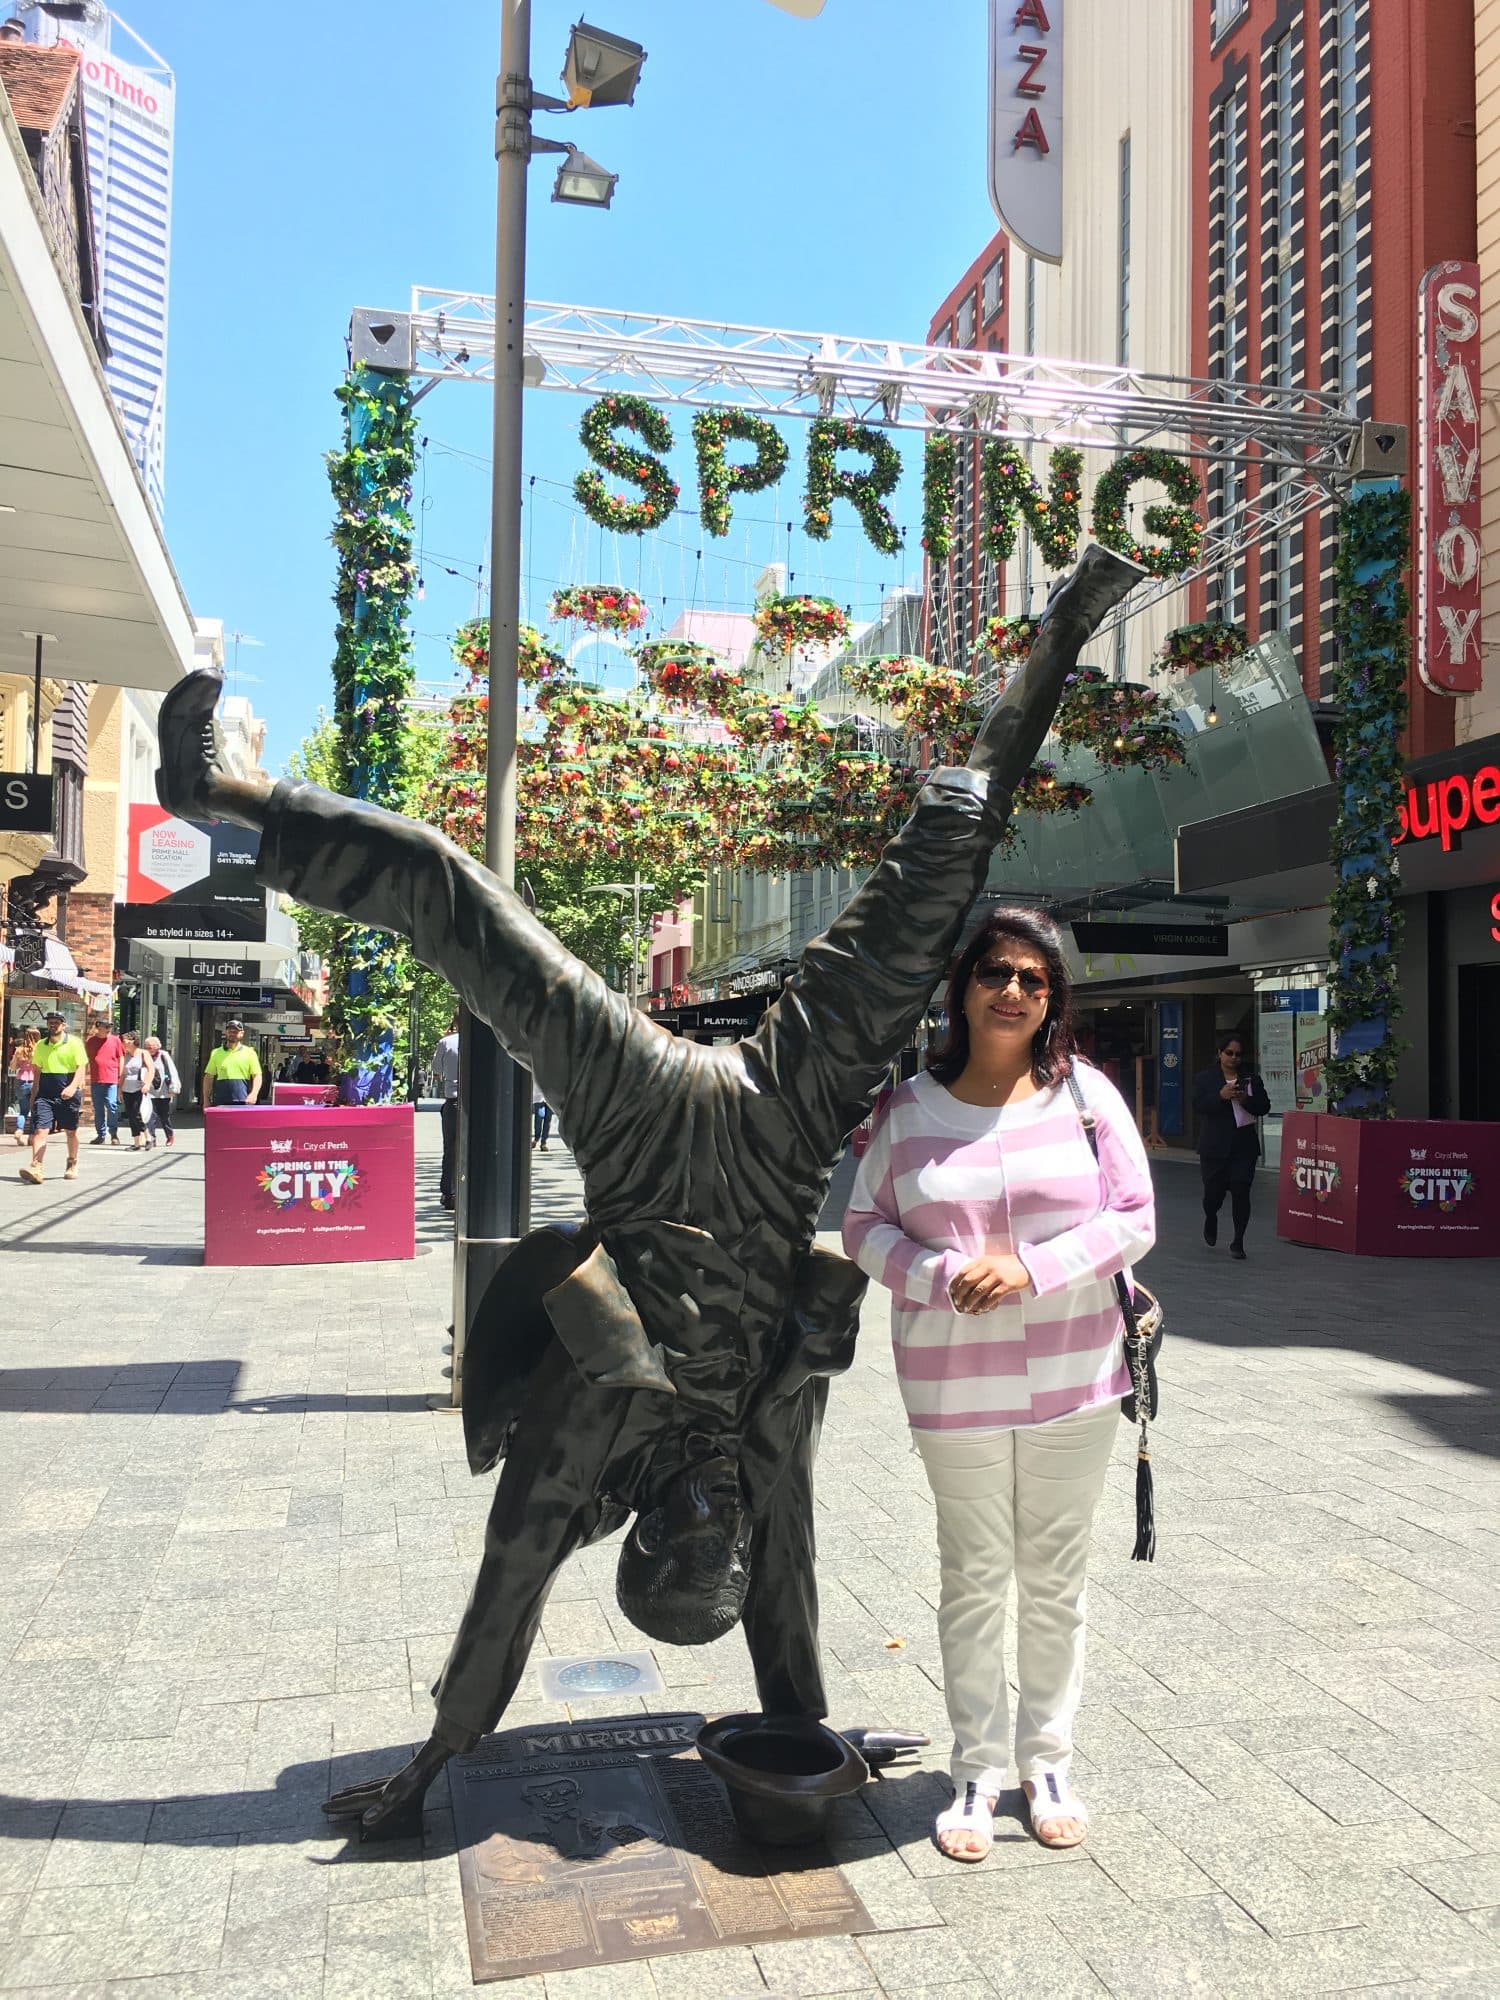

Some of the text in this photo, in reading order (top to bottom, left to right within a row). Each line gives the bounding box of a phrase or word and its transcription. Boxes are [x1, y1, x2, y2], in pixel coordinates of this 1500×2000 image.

[76, 50, 158, 114] oTinto
[1435, 282, 1480, 665] SAVOY
[573, 392, 1203, 579] SPRING
[153, 830, 176, 839] NOW
[152, 840, 195, 848] LEASING
[147, 927, 234, 938] be styled in sizes 14+
[1153, 934, 1219, 943] VIRGIN MOBILE
[192, 961, 243, 977] city chic
[192, 985, 240, 996] PLATINUM
[704, 1017, 748, 1025] PLATYPUS
[303, 1141, 348, 1151] City of Perth
[270, 1160, 349, 1171] SPRING IN THE
[1296, 1156, 1315, 1167] SPRING
[1318, 1160, 1324, 1168] IN
[1409, 1168, 1440, 1176] SPRING
[1453, 1168, 1468, 1177] THE
[1296, 1166, 1336, 1193] CITY
[270, 1172, 348, 1199] CITY
[1409, 1178, 1467, 1201] CITY
[522, 1726, 695, 1756] MIRROR
